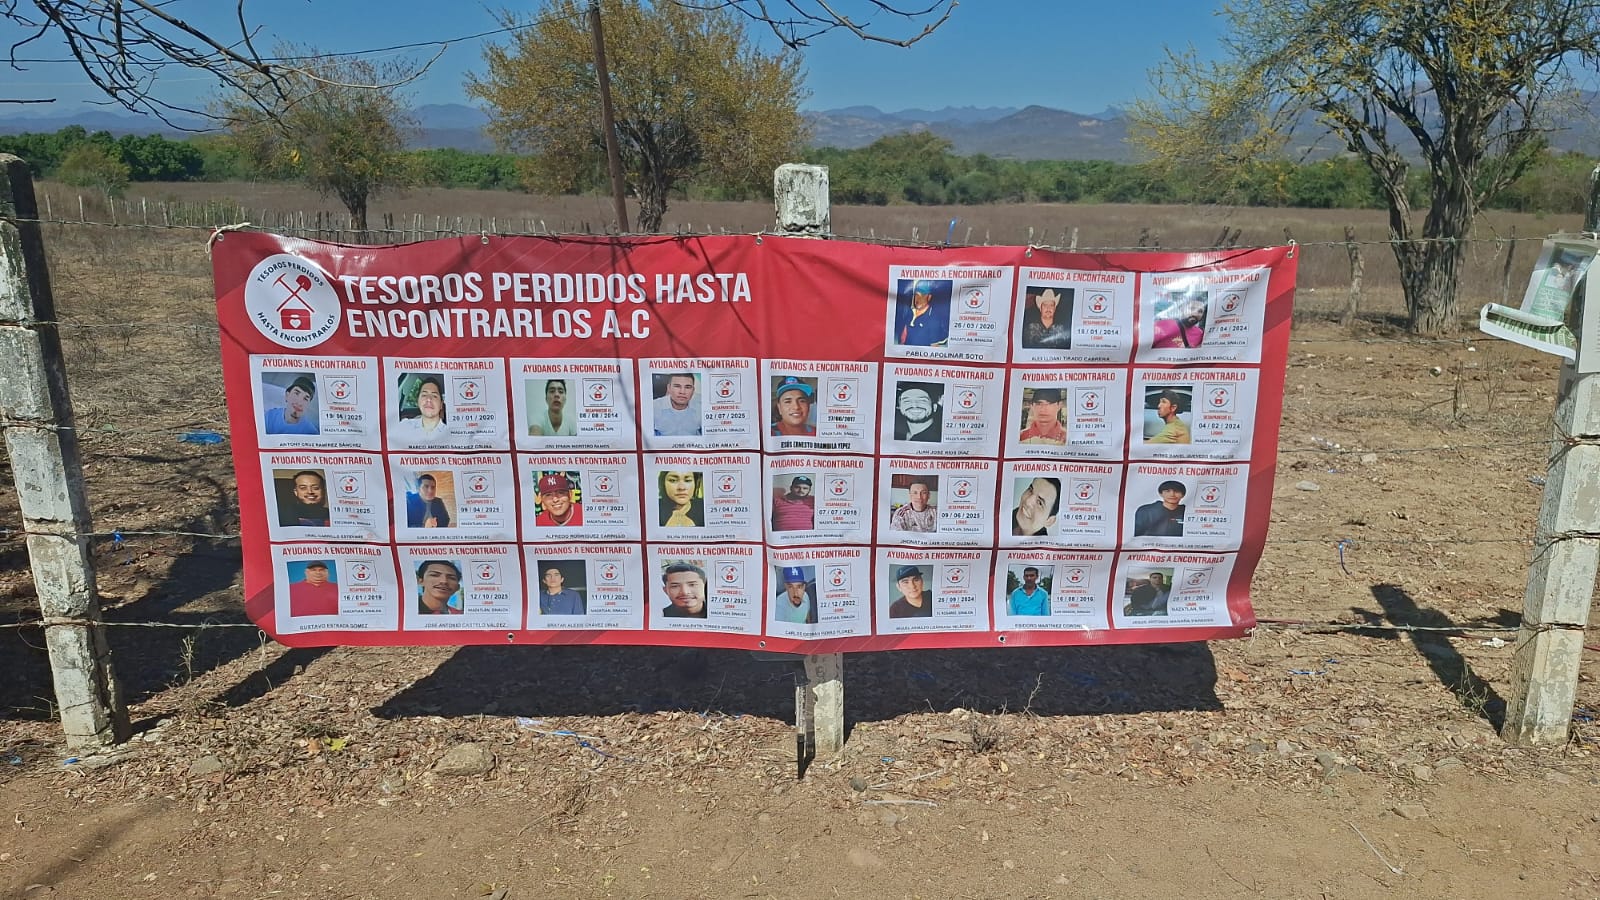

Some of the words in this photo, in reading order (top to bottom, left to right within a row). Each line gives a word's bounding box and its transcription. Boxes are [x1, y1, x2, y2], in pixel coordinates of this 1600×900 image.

[257, 261, 286, 282] TESOROS
[288, 262, 324, 286] PERDIDOS
[901, 270, 939, 278] AYUDANOS
[948, 270, 1002, 278] ENCONTRARLO
[1029, 271, 1064, 280] AYUDANOS
[1073, 273, 1125, 284] ENCONTRARLO
[338, 273, 483, 304] TESOROS
[492, 273, 647, 303] PERDIDOS
[656, 273, 751, 303] HASTA
[258, 312, 278, 335] HASTA
[280, 315, 335, 342] ENCONTRARLOS
[347, 308, 592, 338] ENCONTRARLOS
[602, 309, 649, 338] A.C
[263, 358, 303, 368] AYUDANOS
[311, 360, 366, 369] ENCONTRARLO
[394, 361, 433, 369] AYUDANOS
[441, 362, 494, 370] ENCONTRARLO
[649, 359, 689, 368] AYUDANOS
[690, 359, 695, 368] A
[697, 359, 749, 368] ENCONTRARLO
[771, 361, 807, 371] AYUDANOS
[810, 363, 814, 371] A
[816, 363, 868, 372] ENCONTRARLO
[570, 365, 620, 373] ENCONTRARLO
[895, 367, 932, 377] AYUDANOS
[935, 369, 939, 377] A
[942, 369, 994, 380] ENCONTRARLO
[1022, 374, 1057, 382] AYUDANOS
[1065, 373, 1115, 381] ENCONTRARLO
[1142, 372, 1181, 380] AYUDANOS
[1190, 372, 1245, 381] ENCONTRARLO
[271, 456, 312, 464] AYUDANOS
[313, 456, 318, 464] A
[319, 456, 372, 465] ENCONTRARLO
[400, 457, 439, 465] AYUDANOS
[448, 456, 501, 466] ENCONTRARLO
[575, 457, 626, 465] ENCONTRARLO
[700, 456, 750, 465] ENCONTRARLO
[770, 459, 804, 468] AYUDANOS
[813, 460, 864, 468] ENCONTRARLO
[890, 459, 928, 469] AYUDANOS
[930, 460, 934, 468] A
[936, 460, 989, 469] ENCONTRARLO
[1060, 464, 1112, 473] ENCONTRARLO
[1138, 466, 1177, 475] AYUDANOS
[1186, 468, 1238, 476] ENCONTRARLO
[283, 547, 322, 556] AYUDANOS
[331, 547, 381, 556] ENCONTRARLO
[703, 547, 753, 556] ENCONTRARLO
[773, 553, 804, 561] AYUDANOS
[812, 550, 860, 560] ENCONTRARLO
[888, 551, 923, 560] AYUDANOS
[1128, 555, 1165, 563] AYUDANOS
[1174, 555, 1225, 564] ENCONTRARLO
